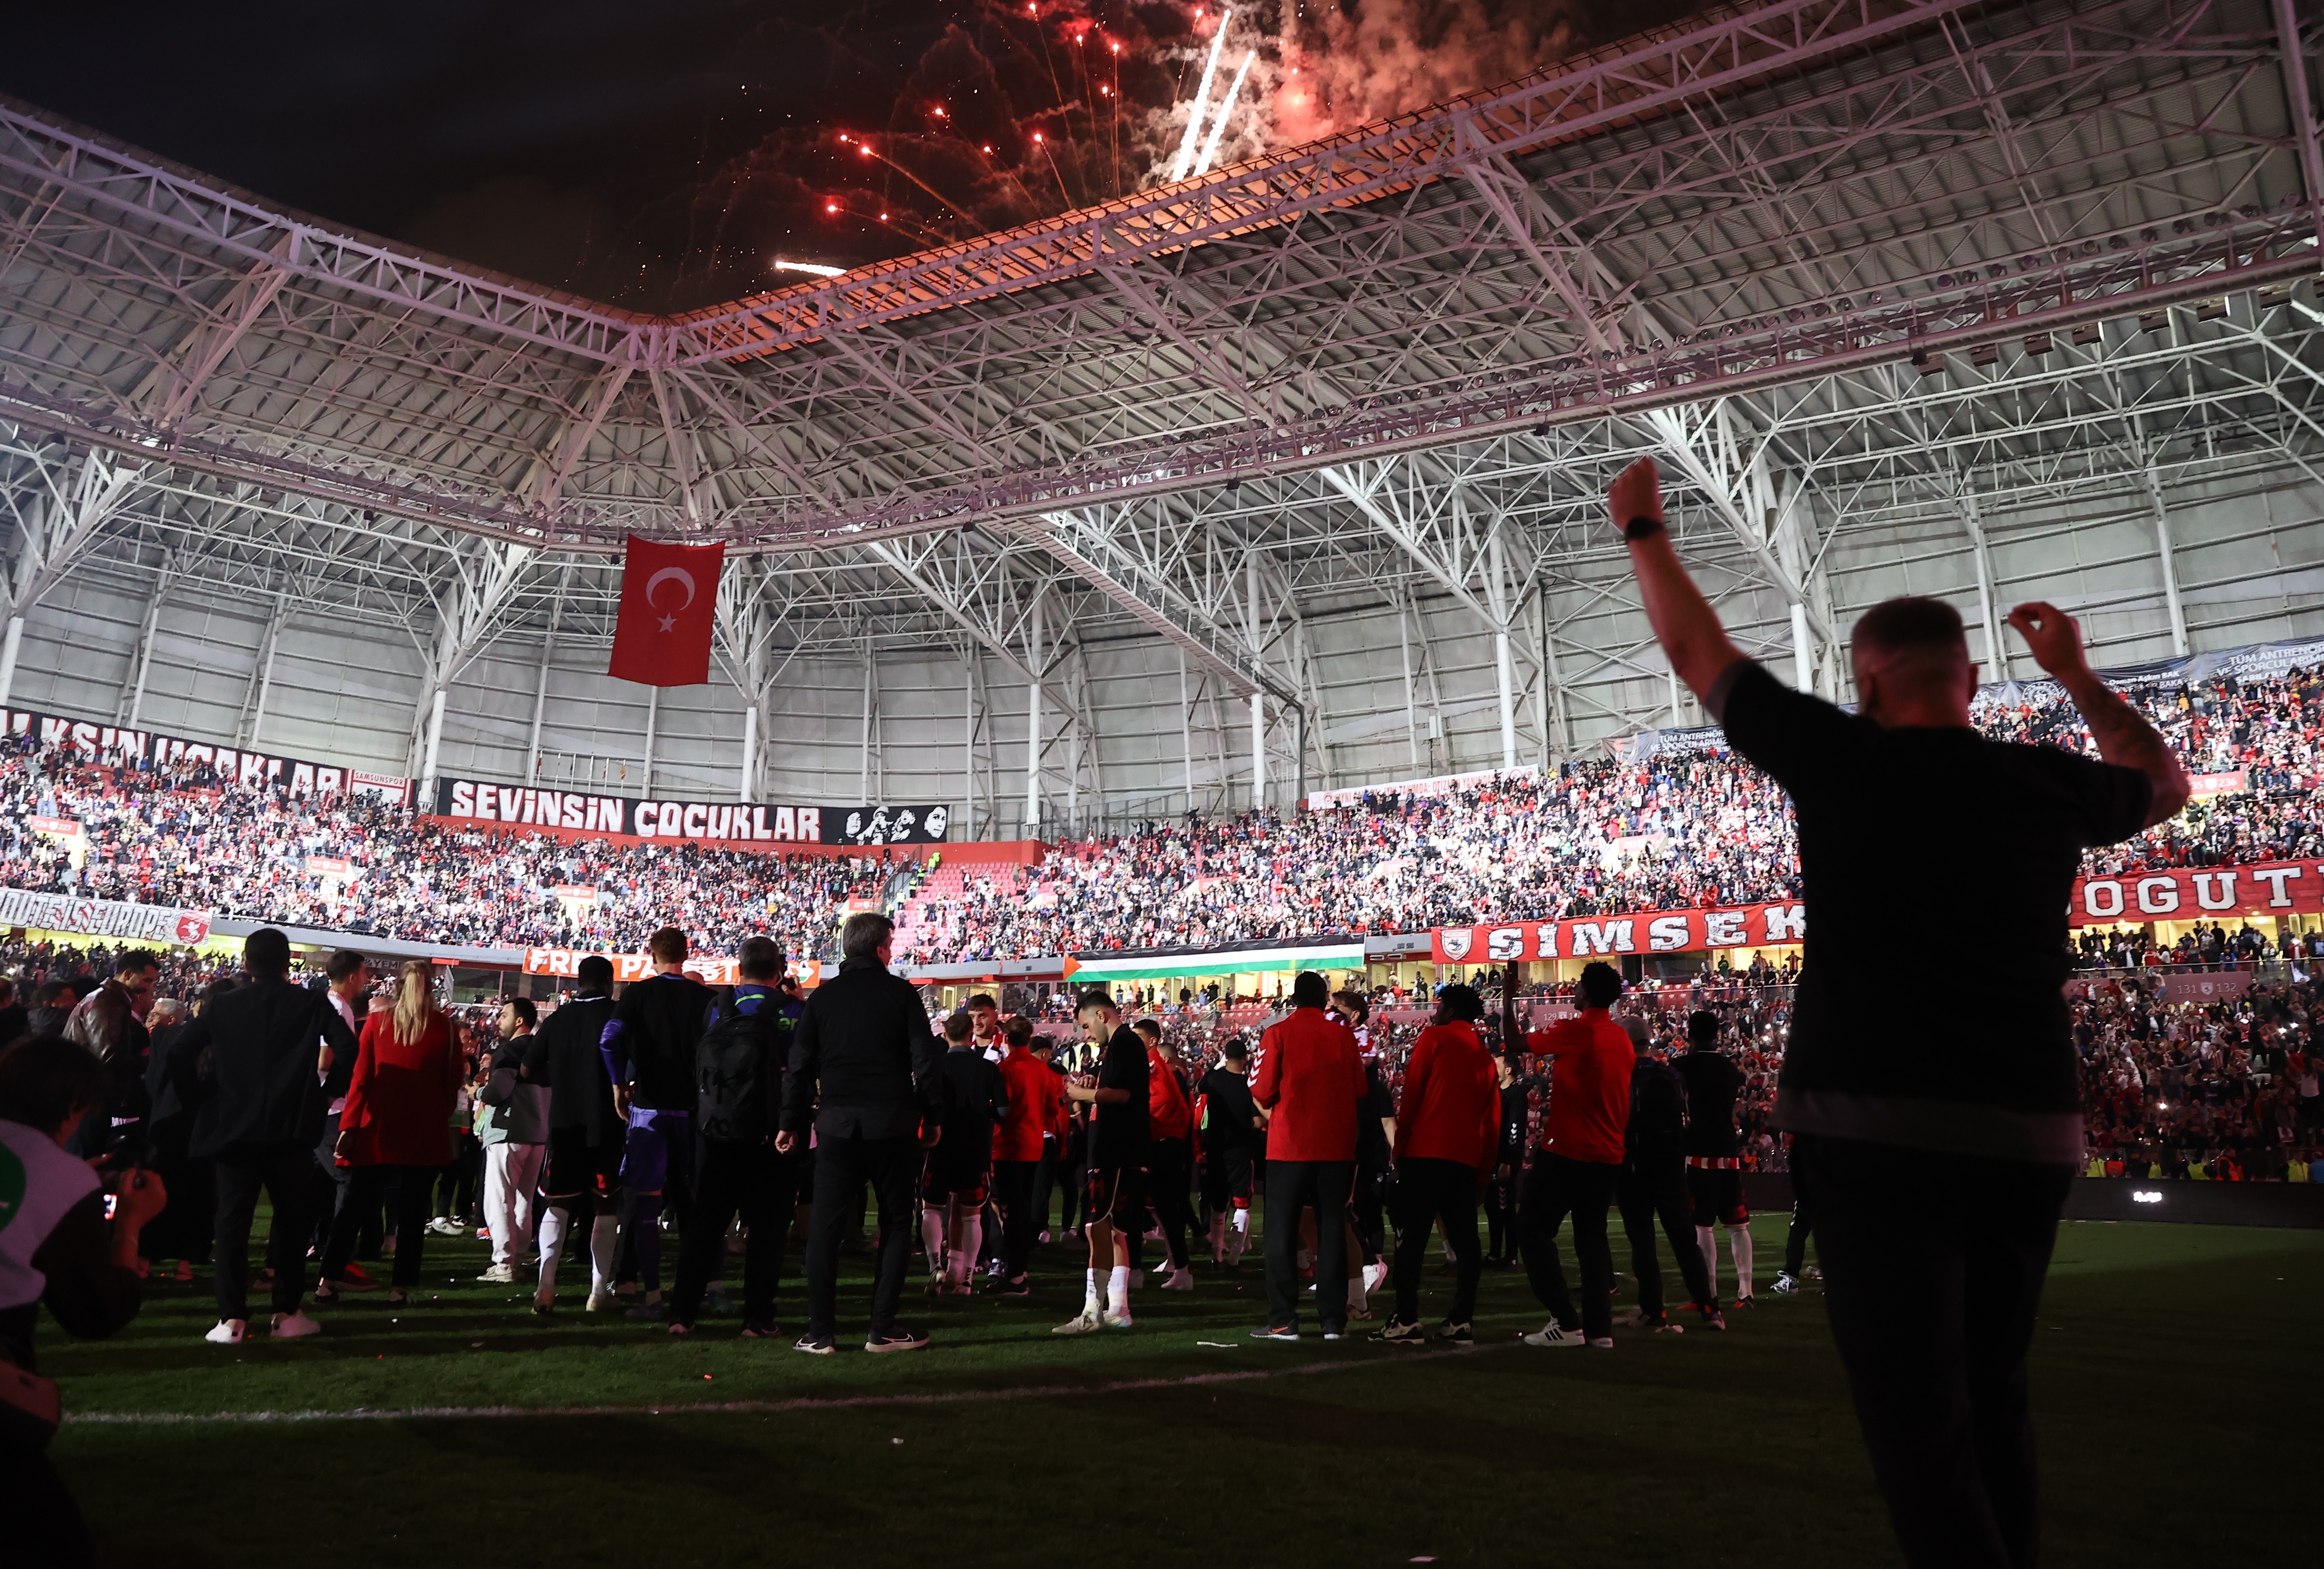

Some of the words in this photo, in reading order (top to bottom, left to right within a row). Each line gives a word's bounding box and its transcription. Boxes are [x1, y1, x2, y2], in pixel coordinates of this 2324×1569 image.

[355, 772, 404, 785] SAMSUNSPOR
[2218, 777, 2237, 787] 236
[87, 902, 172, 942] EUROPE
[2177, 984, 2197, 994] 131
[2216, 983, 2237, 992] 132
[1543, 1013, 1557, 1021] 129
